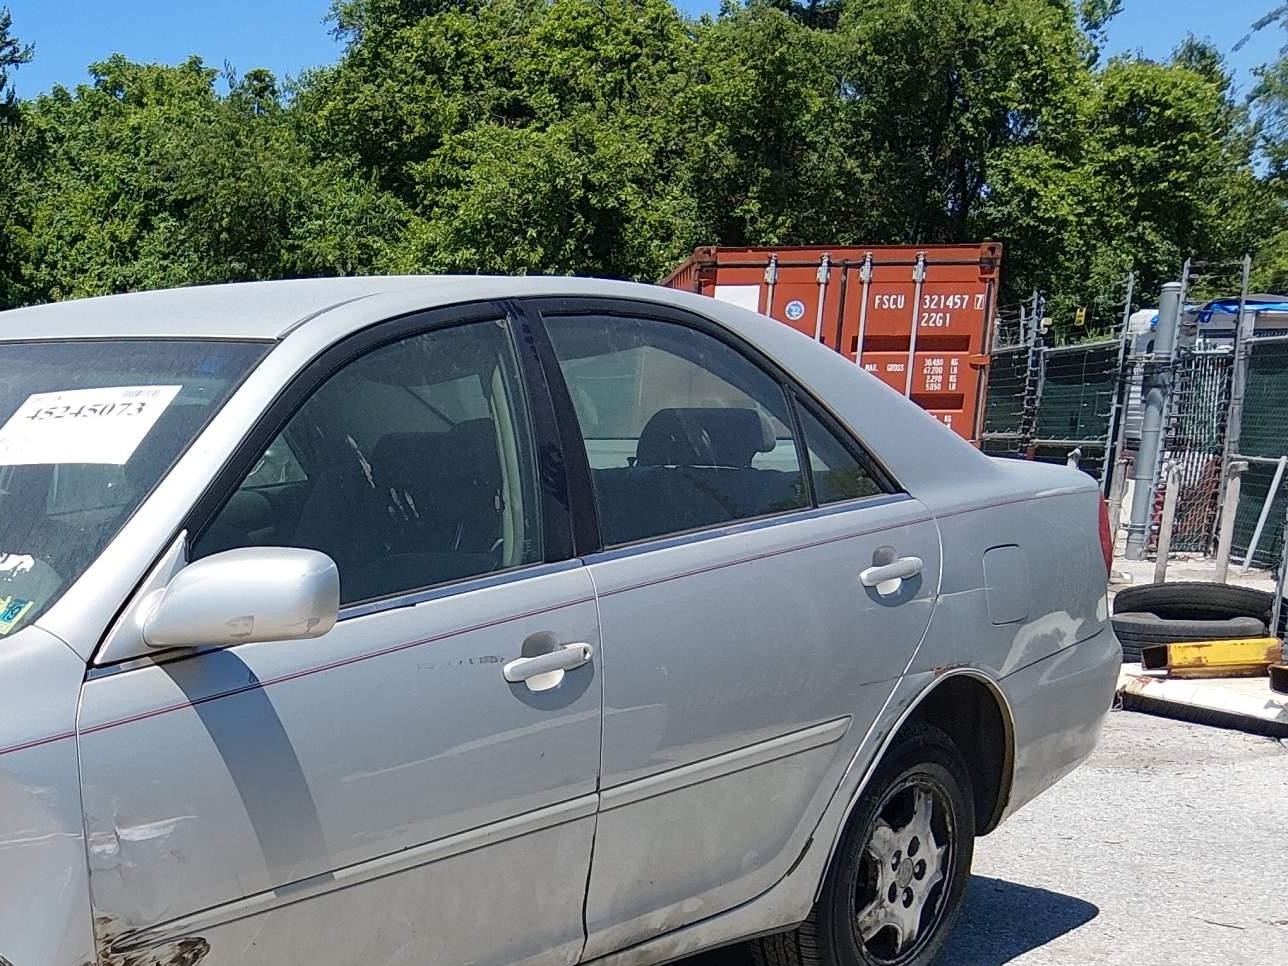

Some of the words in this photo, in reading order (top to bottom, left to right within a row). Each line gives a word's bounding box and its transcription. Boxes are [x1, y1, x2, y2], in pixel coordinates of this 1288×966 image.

[874, 294, 905, 309] FSCU
[922, 294, 969, 309] 321457
[975, 294, 984, 310] 7
[920, 312, 950, 327] 22G1
[886, 364, 905, 372] GROSS
[26, 402, 147, 421] 45245073
